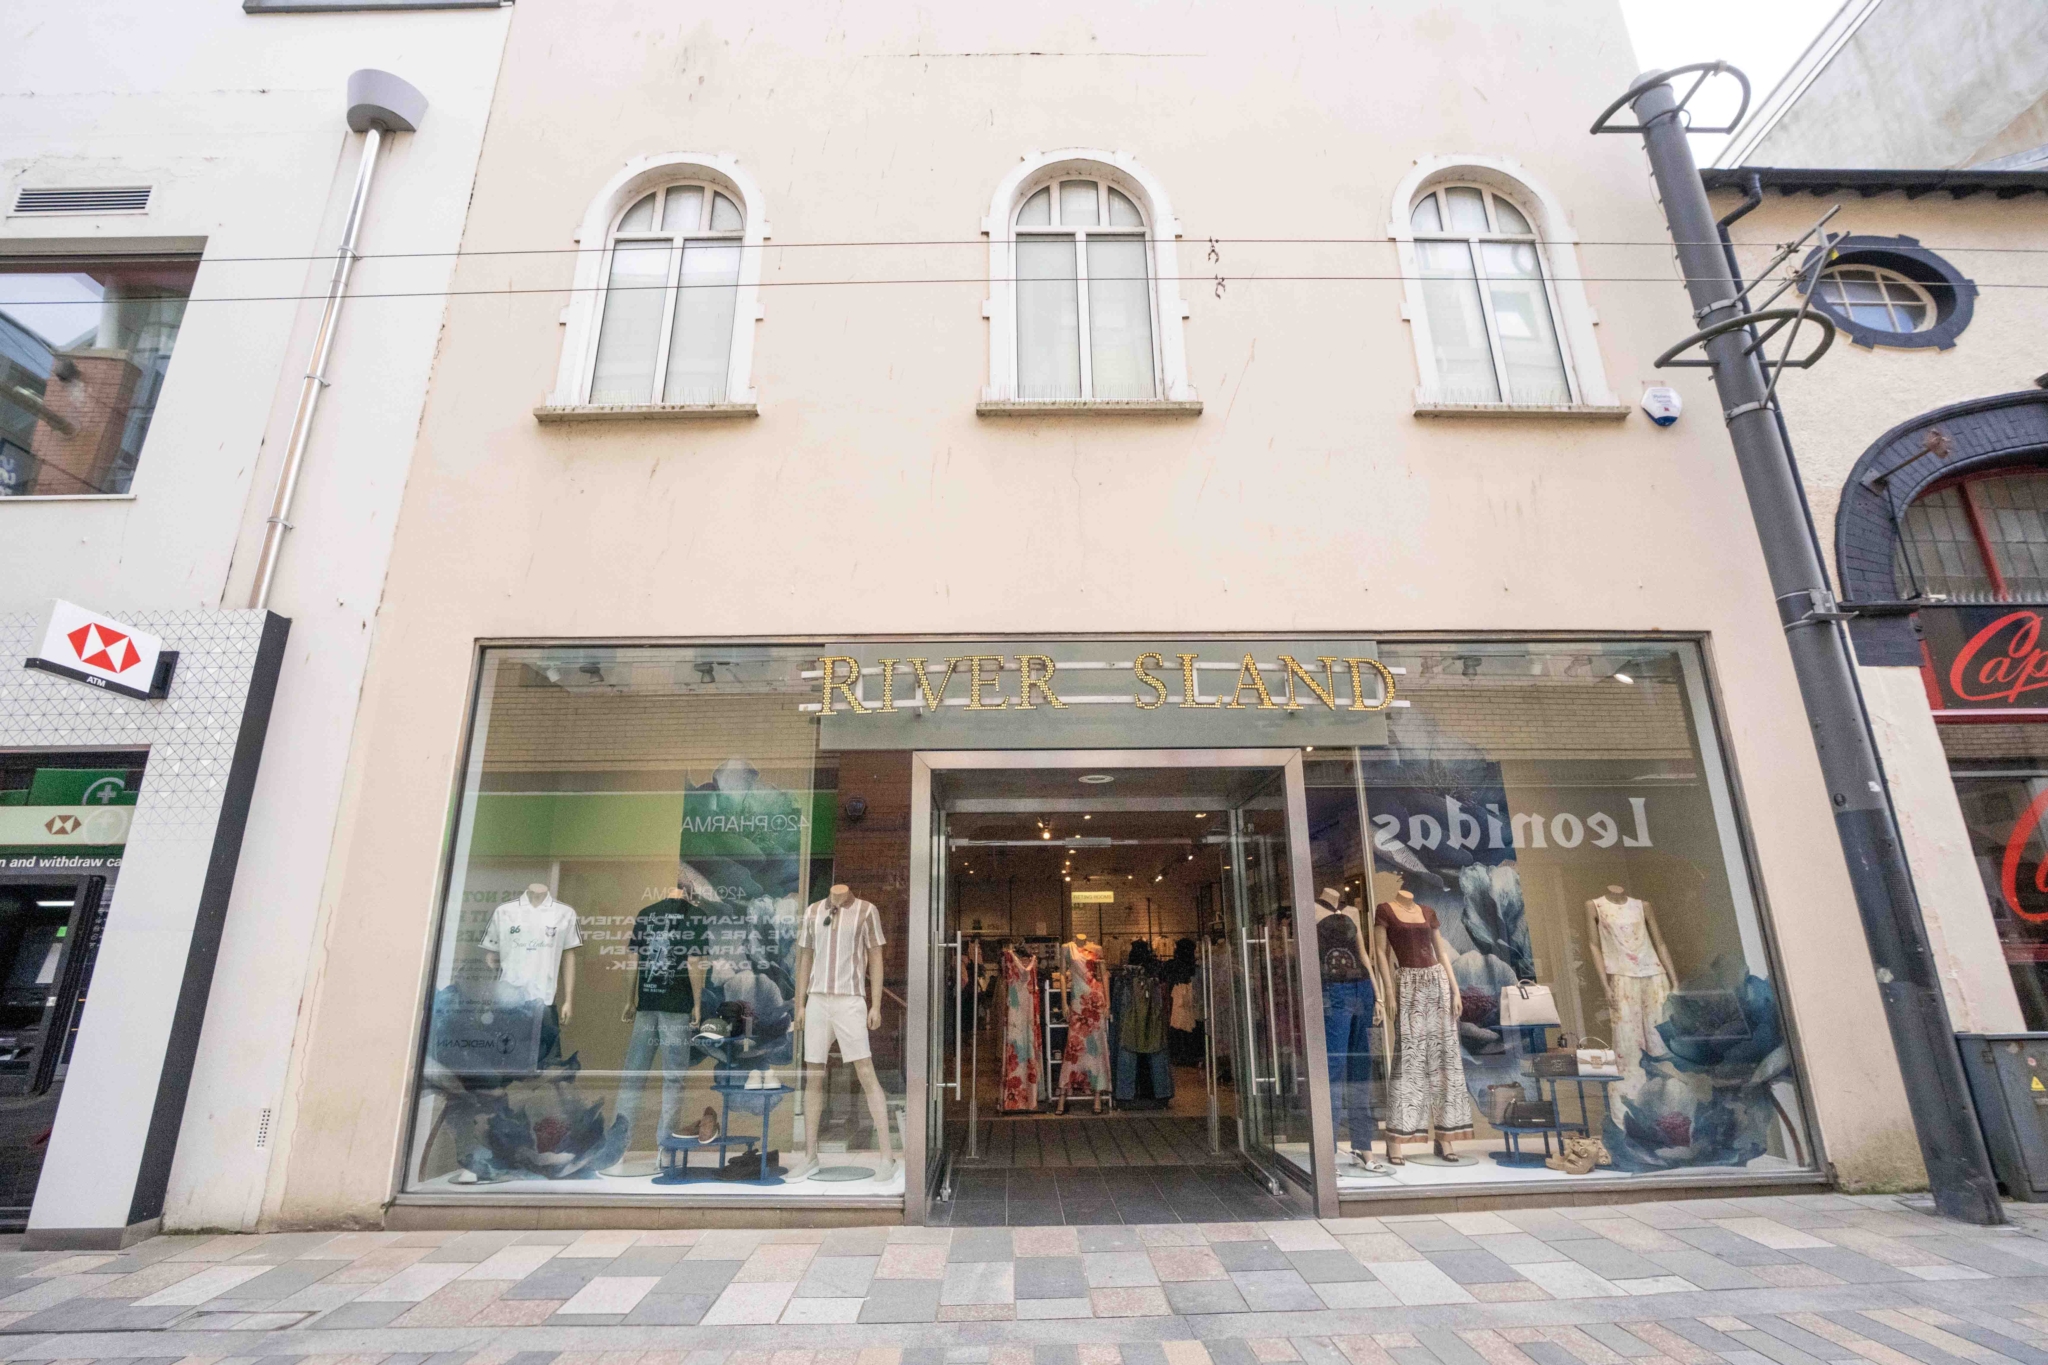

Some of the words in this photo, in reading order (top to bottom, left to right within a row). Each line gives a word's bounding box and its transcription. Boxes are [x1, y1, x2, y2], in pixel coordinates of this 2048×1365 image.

[86, 675, 107, 688] ATM
[814, 655, 1069, 715] RIVER
[1134, 651, 1396, 711] SLAND
[9, 856, 37, 868] and
[40, 856, 104, 868] withdraw
[509, 925, 521, 934] 86
